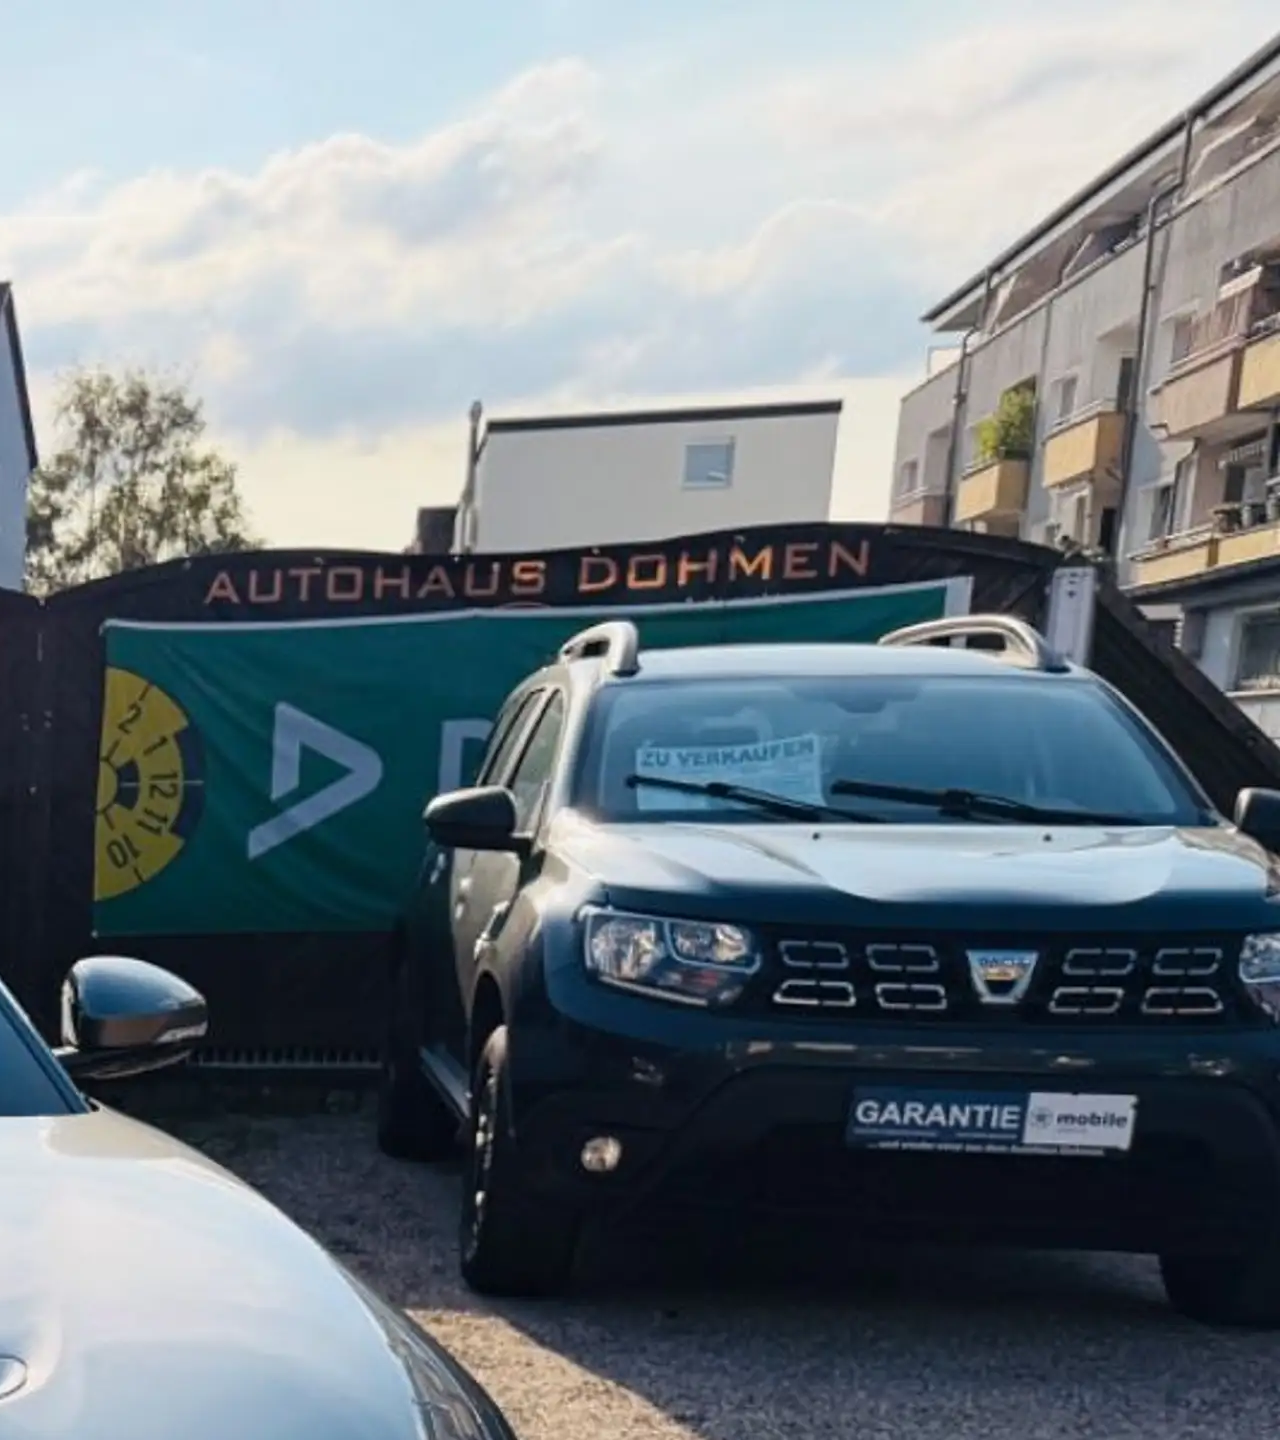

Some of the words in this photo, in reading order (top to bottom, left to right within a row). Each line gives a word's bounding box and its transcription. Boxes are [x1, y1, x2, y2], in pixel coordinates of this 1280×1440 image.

[204, 560, 546, 603] AUTOHAUS
[578, 541, 869, 592] DOHMEN
[117, 702, 142, 734] 2
[642, 749, 670, 767] ZU
[149, 769, 178, 799] 12
[136, 807, 169, 836] 11
[106, 833, 142, 869] 10
[855, 1099, 1021, 1130] GARANTIE
[1055, 1110, 1129, 1129] mobile
